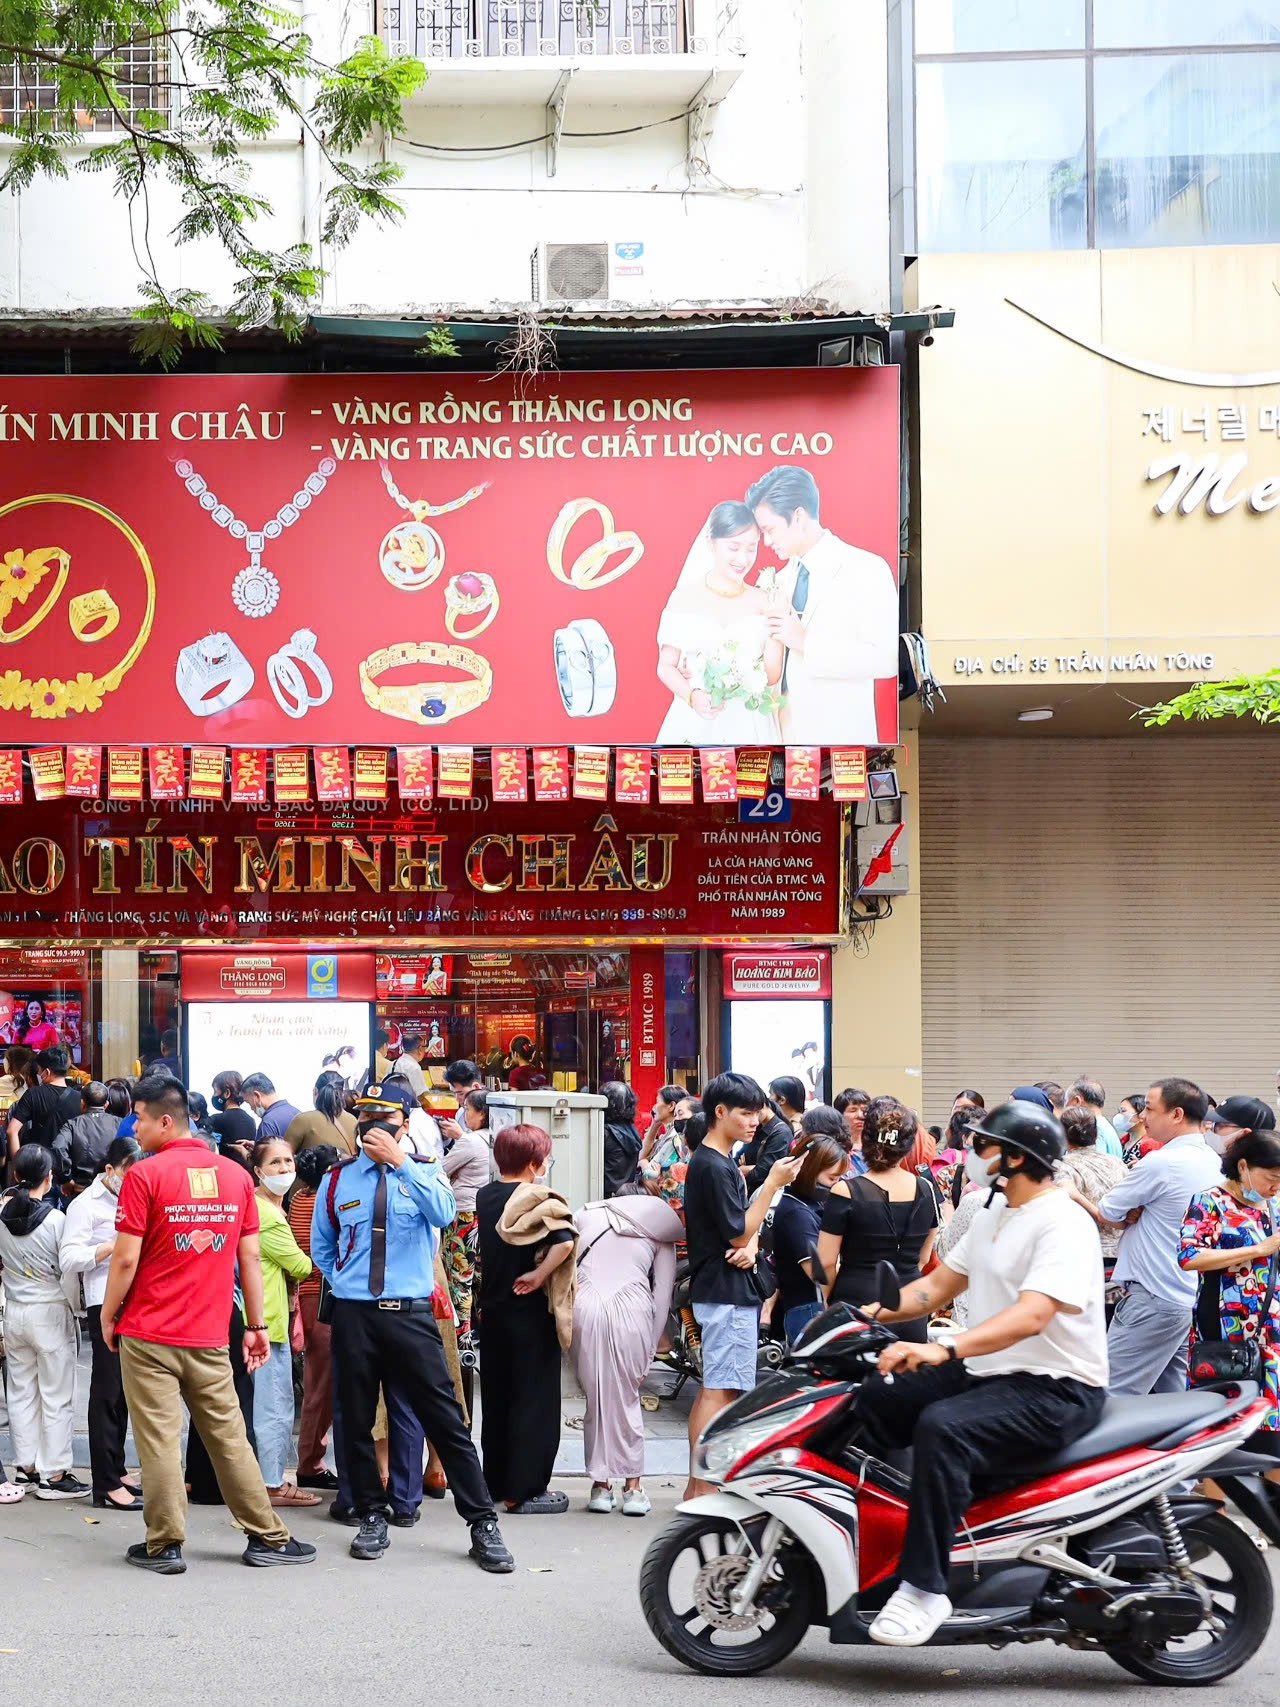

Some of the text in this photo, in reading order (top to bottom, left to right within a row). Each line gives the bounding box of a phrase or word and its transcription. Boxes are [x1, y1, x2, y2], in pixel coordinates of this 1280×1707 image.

[332, 390, 693, 424] VÀNG RỒNG THĂNG LONG
[48, 412, 160, 441] MINH
[170, 403, 286, 441] CHÂU
[330, 424, 833, 464] VÀNG TRANG SỨC CHẤT LƯỢNG CAO
[954, 654, 983, 677] ĐỊA
[1029, 655, 1049, 672] 35
[1109, 651, 1158, 671] NHÂN
[1164, 650, 1215, 671] TÔNG
[140, 799, 160, 813] TY
[168, 799, 214, 813] TNHH
[223, 799, 271, 813] VNG
[449, 795, 489, 812] LTD)
[749, 792, 784, 817] 29
[741, 831, 780, 843] NHÂN
[783, 831, 822, 843] TÔNG
[84, 817, 218, 894] TÍN
[234, 835, 448, 894] MINH
[465, 814, 679, 894] CHÂU
[708, 856, 813, 867] LÀ CỬA HÀNG VÀNG
[723, 872, 748, 884] TIÊN
[750, 872, 773, 884] CỦA
[776, 873, 808, 884] BTMC
[811, 873, 825, 884] VÀ
[755, 889, 788, 901] NHÂN
[790, 889, 822, 901] TÔNG
[148, 911, 171, 922] SJC
[731, 906, 785, 918] NĂM 1989
[25, 950, 44, 958] TRANG
[222, 971, 284, 981] THĂNG LONG
[736, 965, 772, 979] HOÀNG
[773, 968, 793, 979] KIM
[643, 973, 654, 1044] BTMC 1989
[164, 1203, 239, 1214] PHỤC VỤ KHÁCH HÀN
